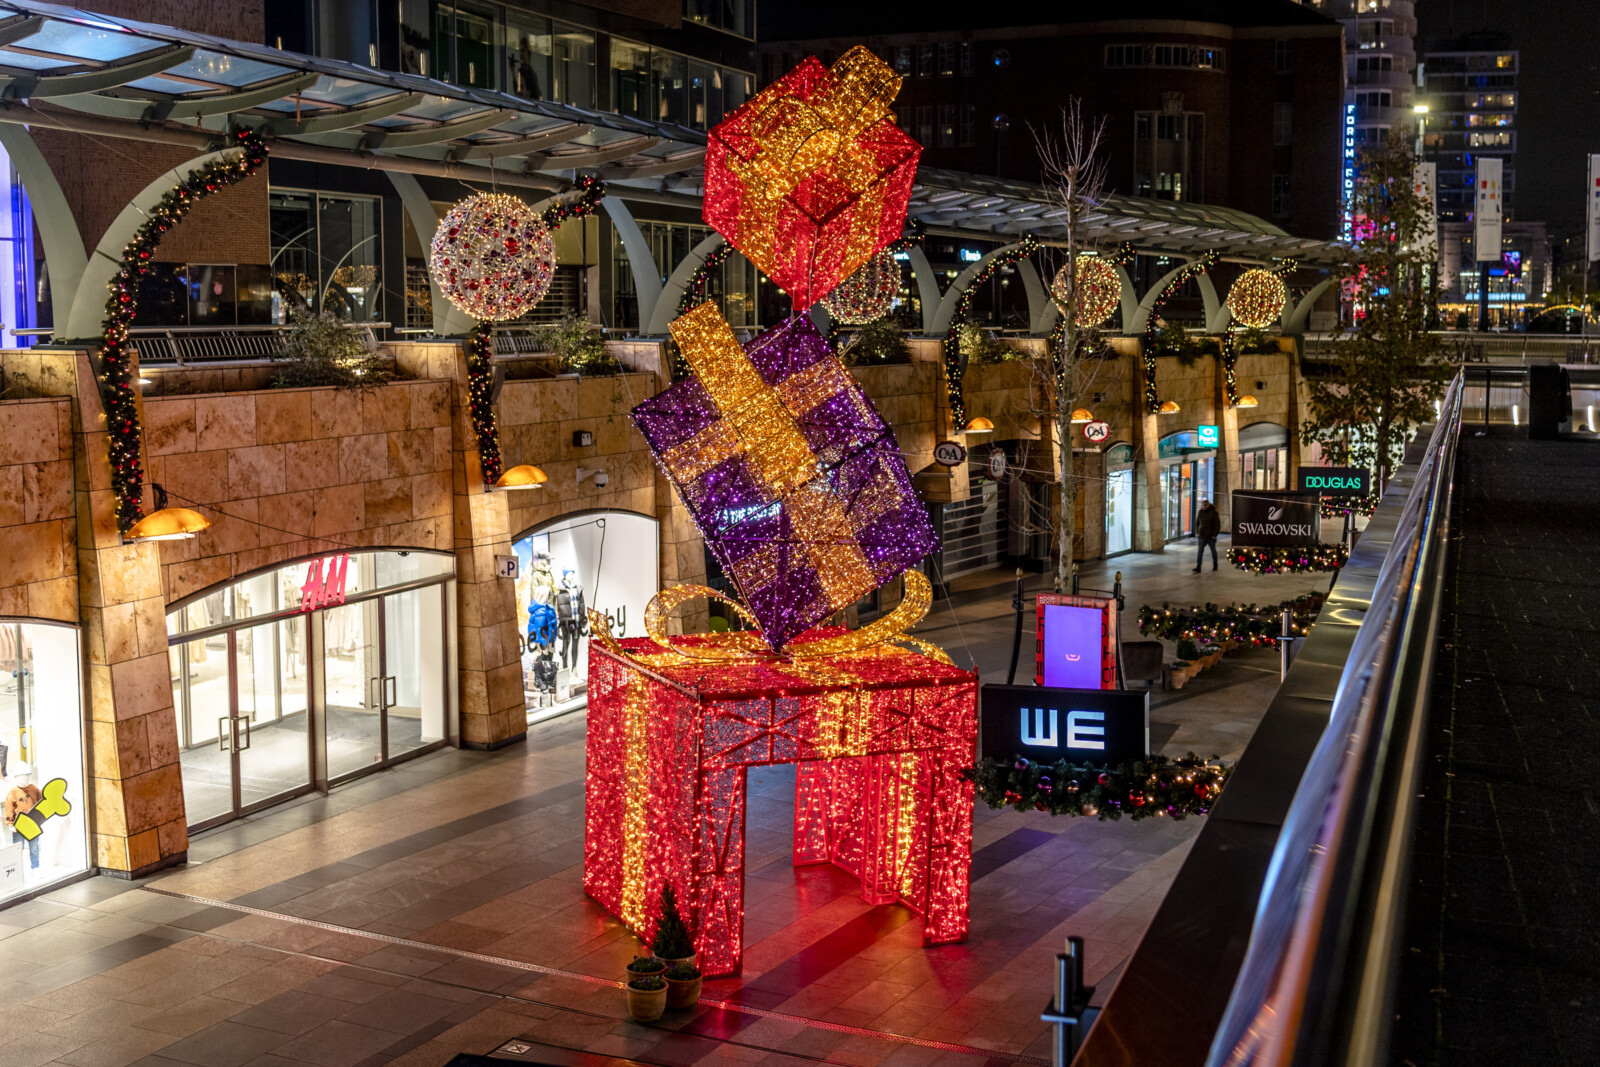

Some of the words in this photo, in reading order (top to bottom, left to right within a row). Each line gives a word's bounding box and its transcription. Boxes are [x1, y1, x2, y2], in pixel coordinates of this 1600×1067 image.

[1345, 105, 1355, 158] FORUM
[938, 447, 959, 461] C&A
[1305, 476, 1361, 489] DOUGLAS
[1239, 522, 1311, 536] SWAROVSKI
[507, 561, 515, 576] P
[300, 553, 349, 611] H&M
[1020, 707, 1105, 750] WE
